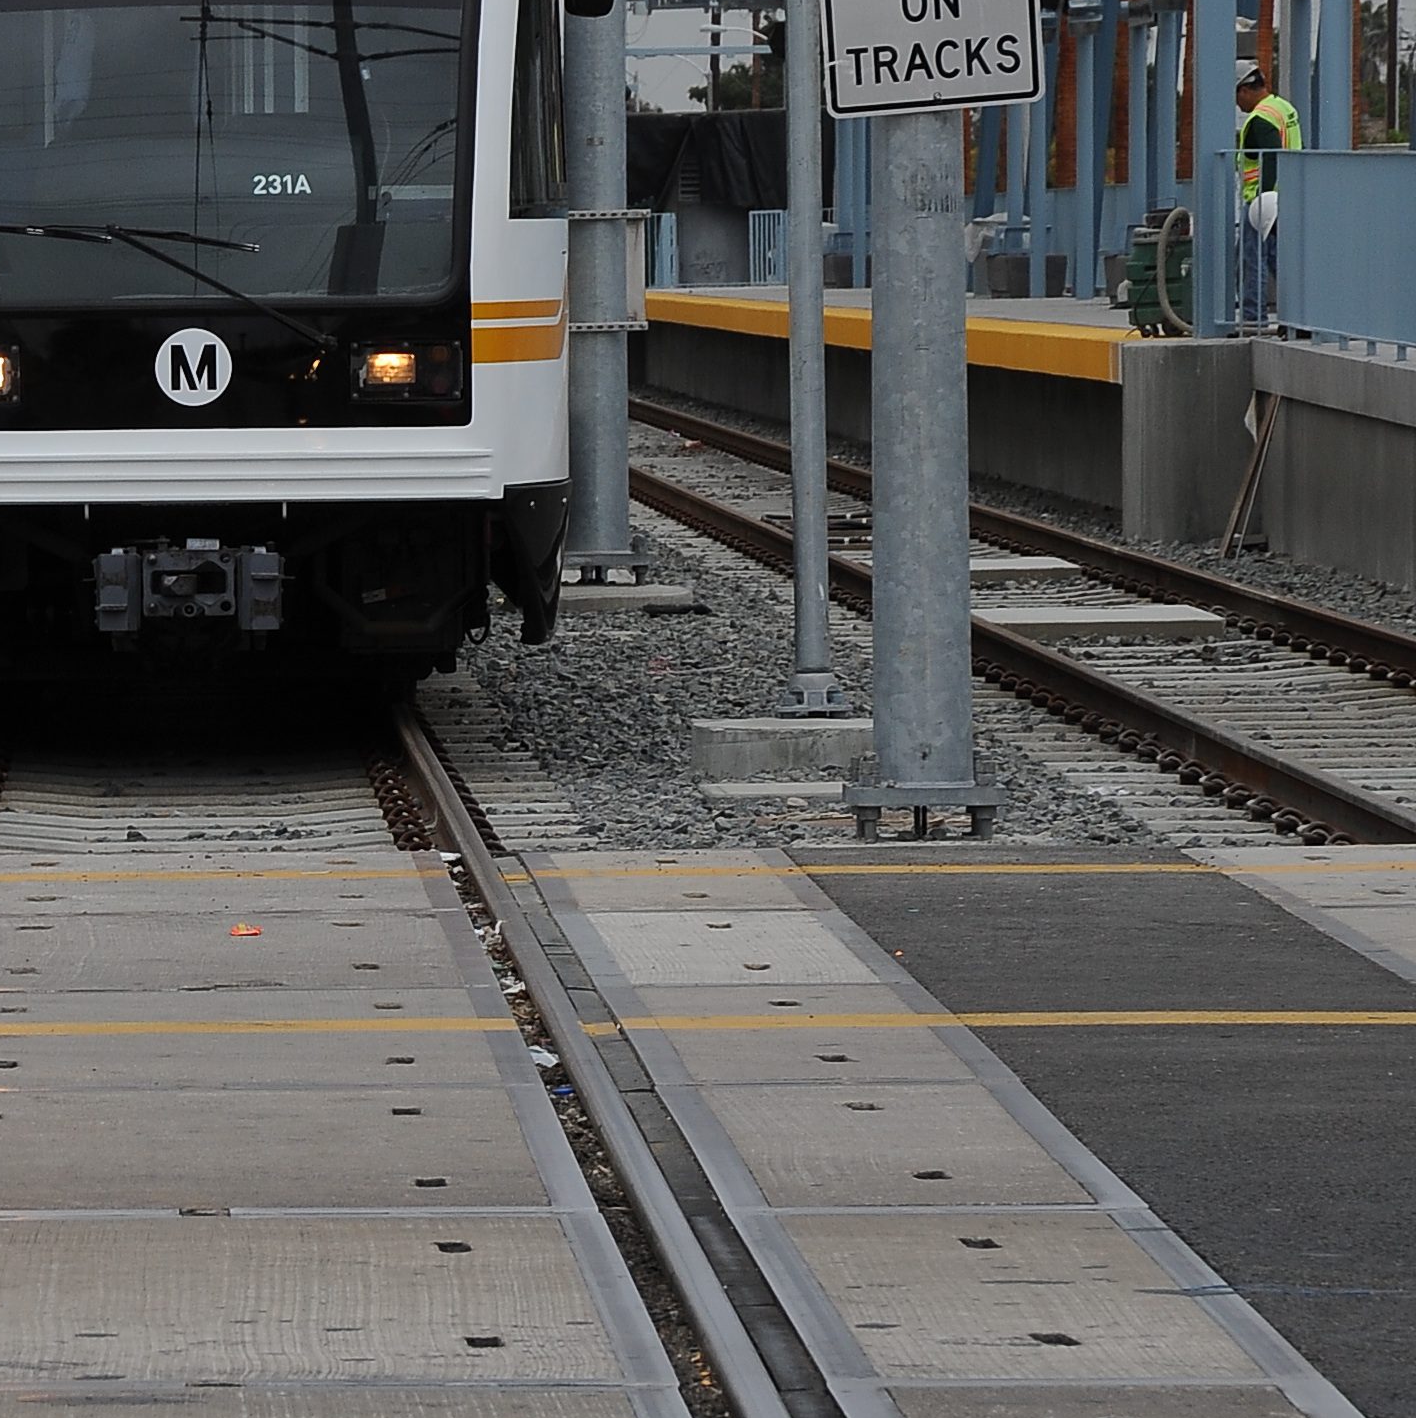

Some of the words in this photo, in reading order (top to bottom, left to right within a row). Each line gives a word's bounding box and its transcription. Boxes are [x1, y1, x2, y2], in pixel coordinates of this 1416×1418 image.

[845, 33, 1021, 86] TRACKS
[252, 173, 312, 195] 231A
[169, 343, 218, 392] M
